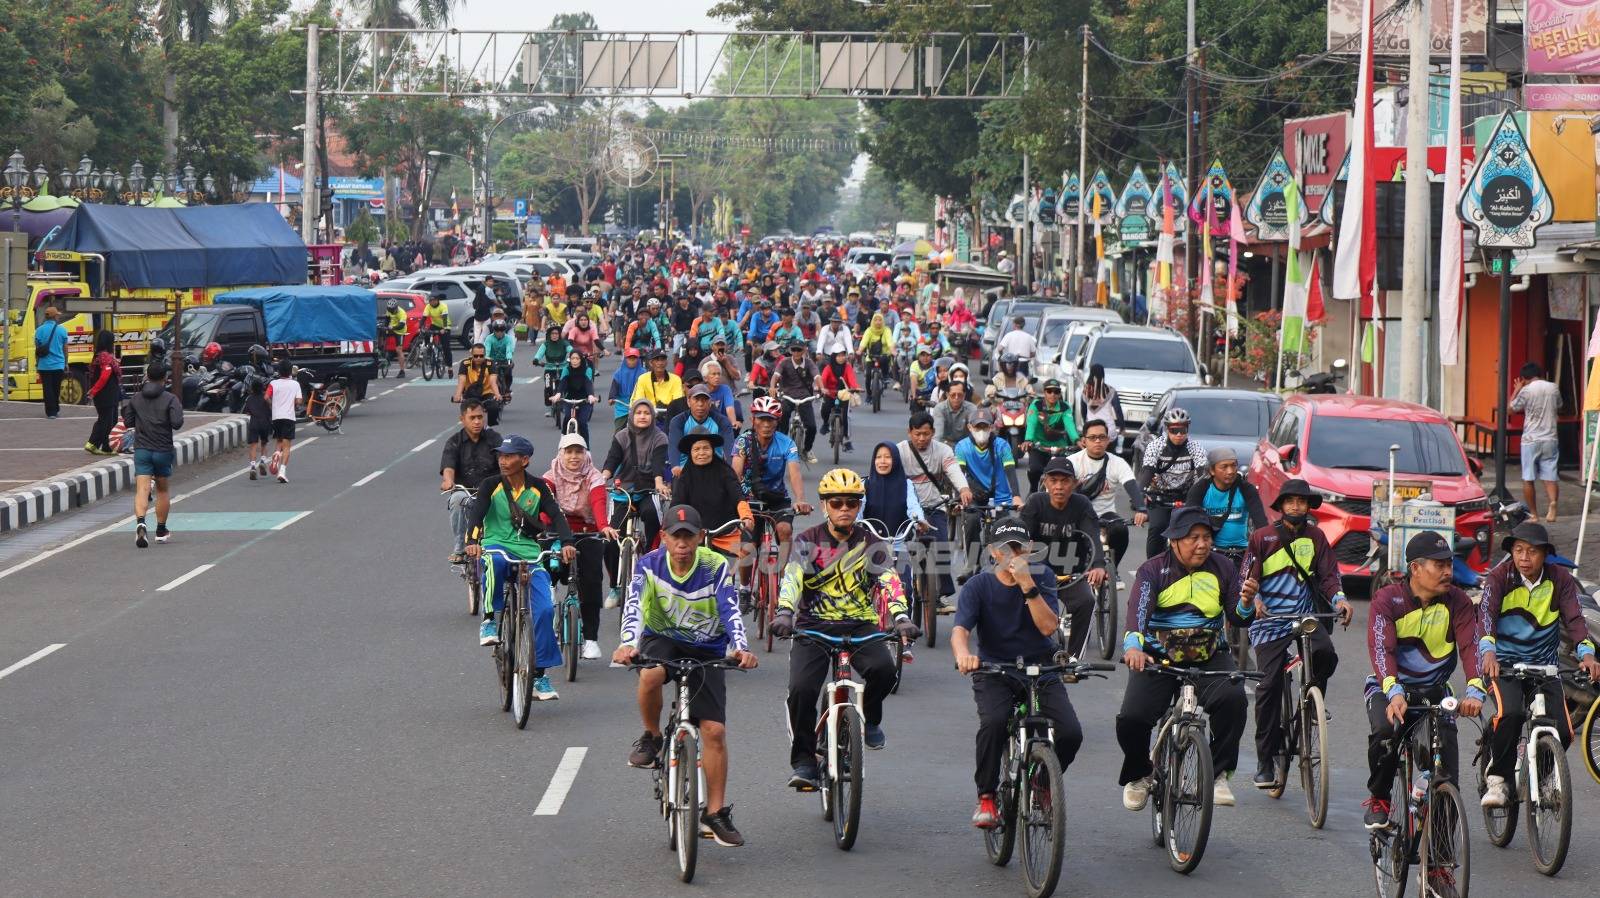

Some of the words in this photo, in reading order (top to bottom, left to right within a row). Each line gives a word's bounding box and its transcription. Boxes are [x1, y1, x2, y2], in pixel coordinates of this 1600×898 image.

[1531, 24, 1588, 51] REFILL
[1504, 151, 1513, 159] 37
[516, 201, 525, 215] P
[676, 508, 687, 521] 1
[1418, 508, 1442, 517] Cilok
